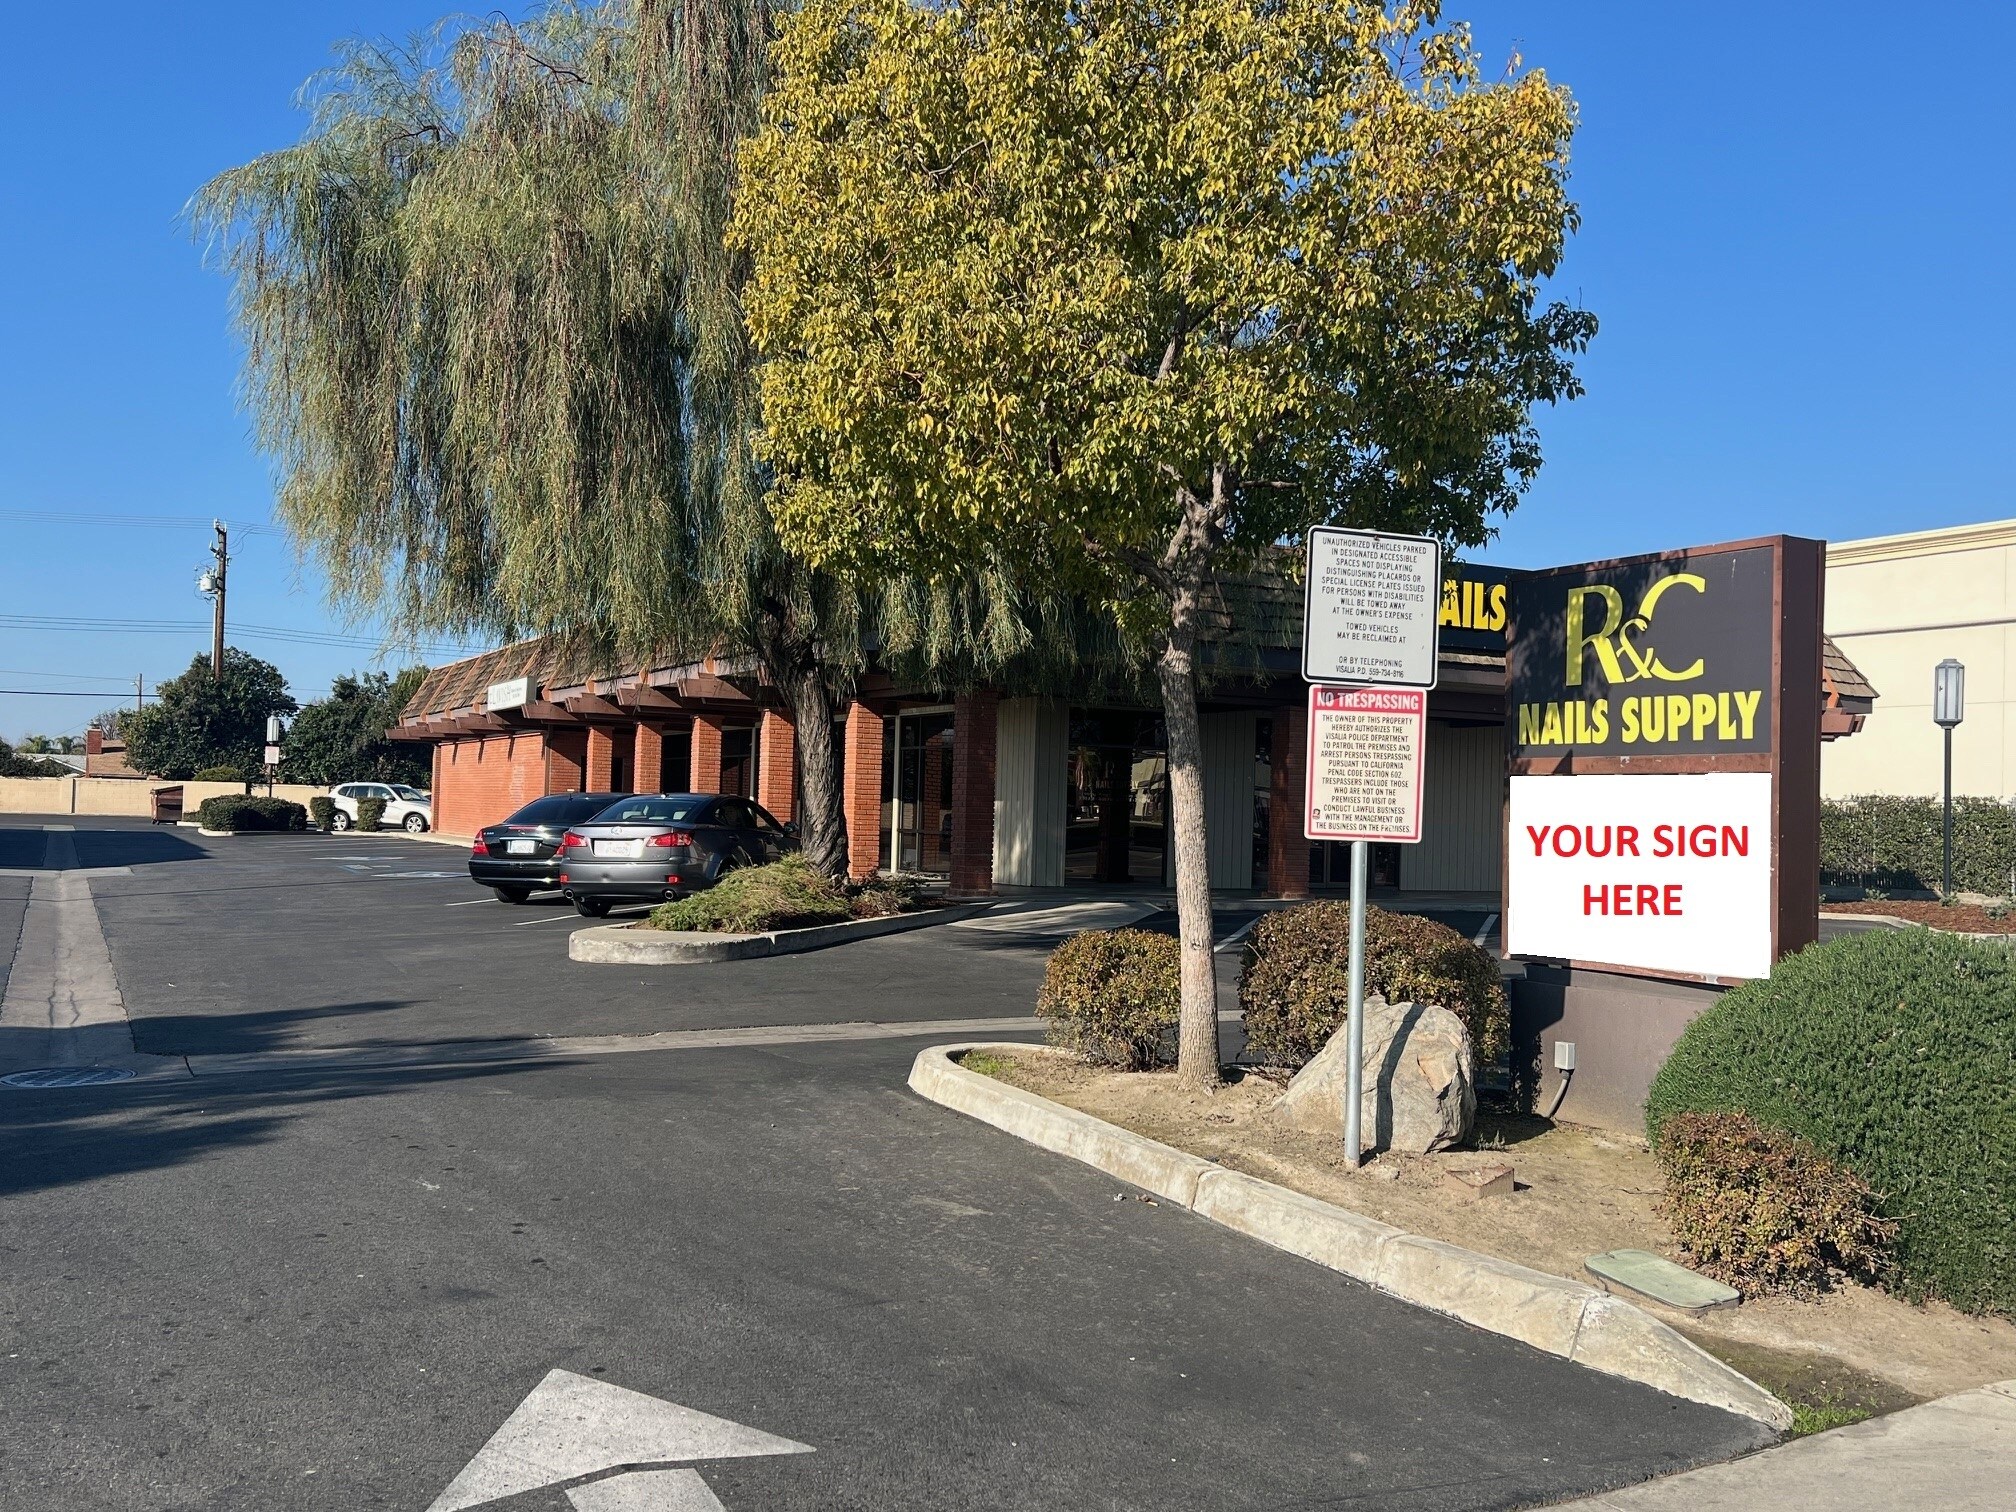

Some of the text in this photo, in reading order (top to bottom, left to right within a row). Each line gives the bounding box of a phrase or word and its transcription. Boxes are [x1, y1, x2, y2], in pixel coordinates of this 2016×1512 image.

[1323, 538, 1426, 554] UNAUTHORIZED VEHICLES PARKED
[1340, 549, 1378, 559] DESIGNATED
[1380, 552, 1417, 563] ACCESSIBLE
[1336, 558, 1360, 567] SPACES
[1376, 562, 1413, 572] DISPLAYING
[1327, 567, 1376, 578] DISTINGUISHING
[1378, 572, 1410, 582] PLACARDS
[1322, 576, 1425, 593] SPECIAL LICENSE PLATES ISSUED
[1322, 586, 1424, 602] FOR PERSONS WITH DISABILITIES
[1368, 600, 1387, 608] TOWED
[1356, 609, 1382, 618] OWNER'S
[1385, 611, 1413, 620] EXPENSE
[1346, 622, 1398, 634] TOWED VEHICLES
[1565, 573, 1706, 686] R&C
[1362, 634, 1397, 643] RECLAIMED
[1360, 658, 1402, 668] TELEPHONING
[1336, 665, 1355, 674] VISALIA
[1317, 692, 1419, 710] NO TRESPASSING
[1382, 717, 1412, 725] PROPERTY
[1518, 690, 1762, 746] NAILS SUPPLY
[1355, 725, 1390, 733] AUTHORIZES
[1371, 734, 1408, 742] DEPARTMENT
[1373, 752, 1412, 761] TRESPASSING
[1322, 777, 1362, 786] TRESPASSERS
[1354, 815, 1393, 823] MANAGEMENT
[1526, 824, 1749, 858] YOUR SIGN
[1584, 884, 1683, 916] HERE
